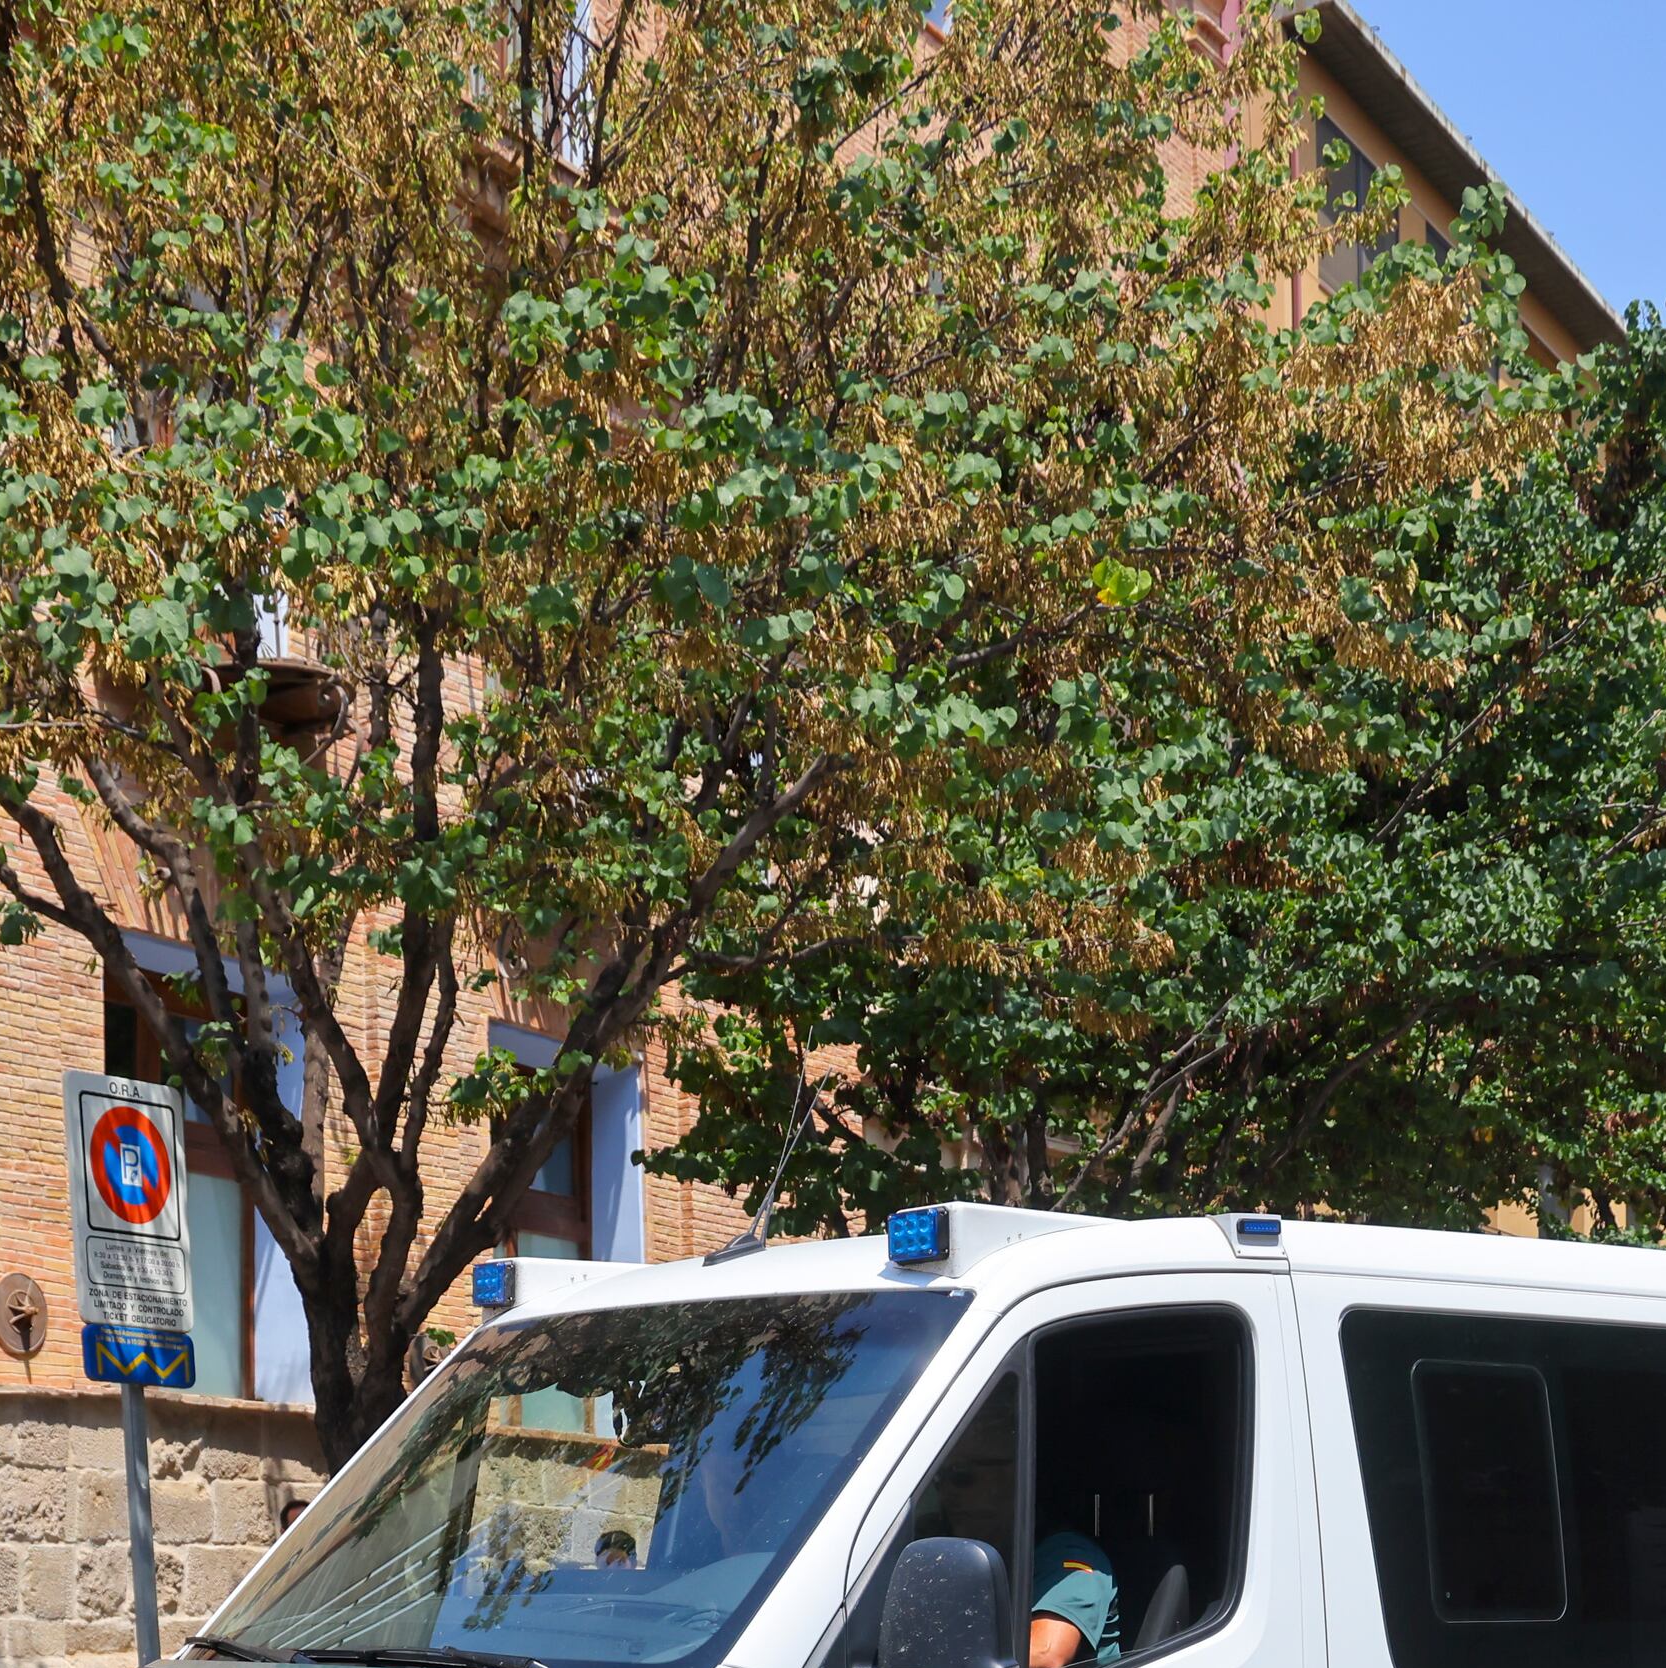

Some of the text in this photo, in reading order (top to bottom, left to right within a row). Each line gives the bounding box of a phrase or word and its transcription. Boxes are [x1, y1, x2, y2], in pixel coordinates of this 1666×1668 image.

[109, 1081, 143, 1099] O.R.A.
[89, 1288, 188, 1307] ZONA DE ESTACIONAMIENTO
[93, 1300, 185, 1317] LIMITADO Y CONTROLADO
[103, 1311, 177, 1327] TICKET OBLIGATORIO
